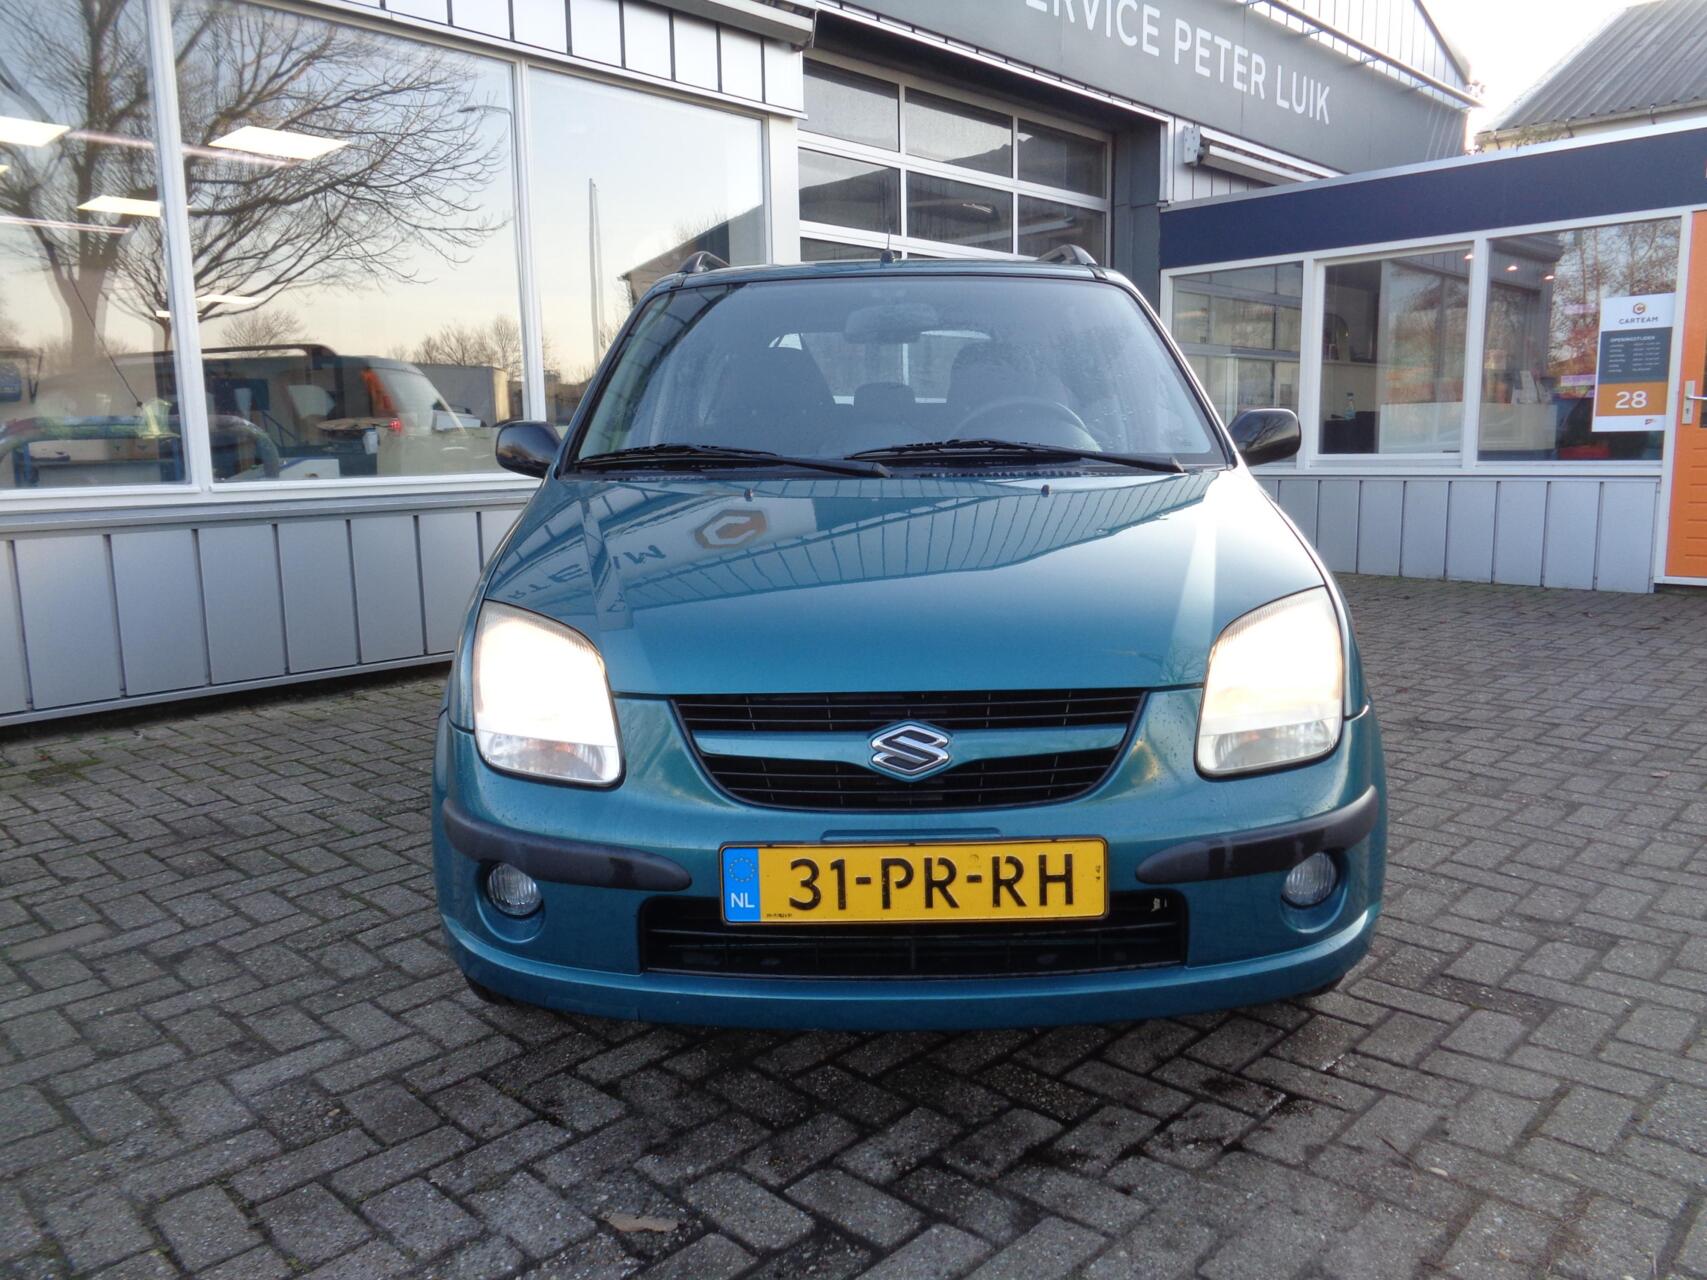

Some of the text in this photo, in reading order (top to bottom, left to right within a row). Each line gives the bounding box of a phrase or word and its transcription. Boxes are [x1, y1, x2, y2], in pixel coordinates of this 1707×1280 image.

[1174, 18, 1266, 99] PETER
[1276, 65, 1330, 125] LUIK
[1618, 316, 1659, 325] CARTEAM
[1615, 390, 1648, 409] 28
[788, 853, 1074, 911] 31-PR-RH
[730, 893, 755, 908] NL
